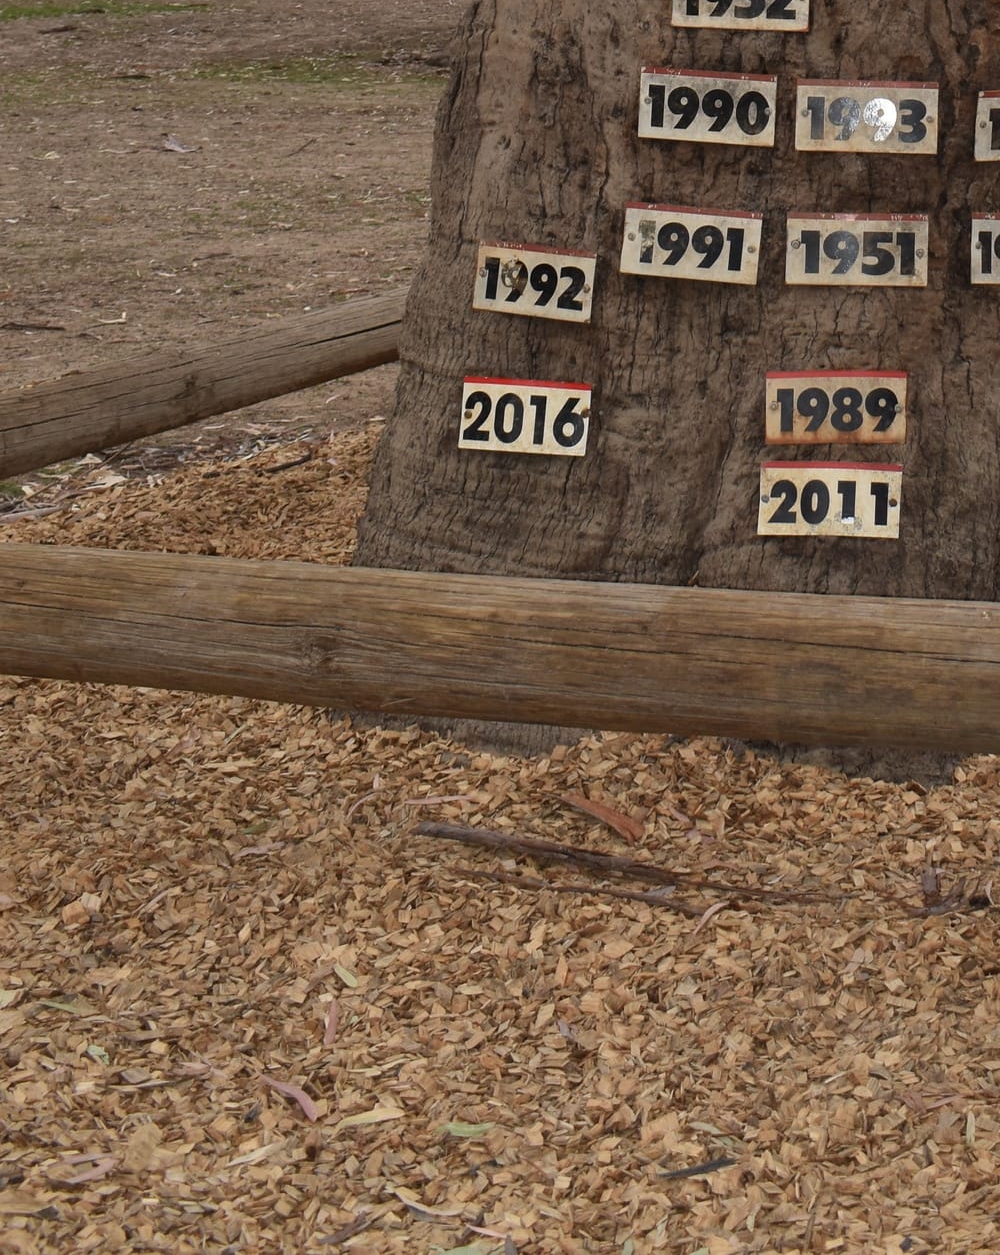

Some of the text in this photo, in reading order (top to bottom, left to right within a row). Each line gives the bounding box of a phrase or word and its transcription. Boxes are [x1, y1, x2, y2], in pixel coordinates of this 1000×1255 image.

[647, 84, 769, 135] 1990
[806, 96, 927, 144] 1993
[640, 220, 744, 271] 1991
[800, 230, 916, 276] 1951
[485, 257, 586, 311] 1992
[462, 391, 584, 447] 2016
[777, 387, 899, 433] 1989
[768, 479, 889, 526] 2011
